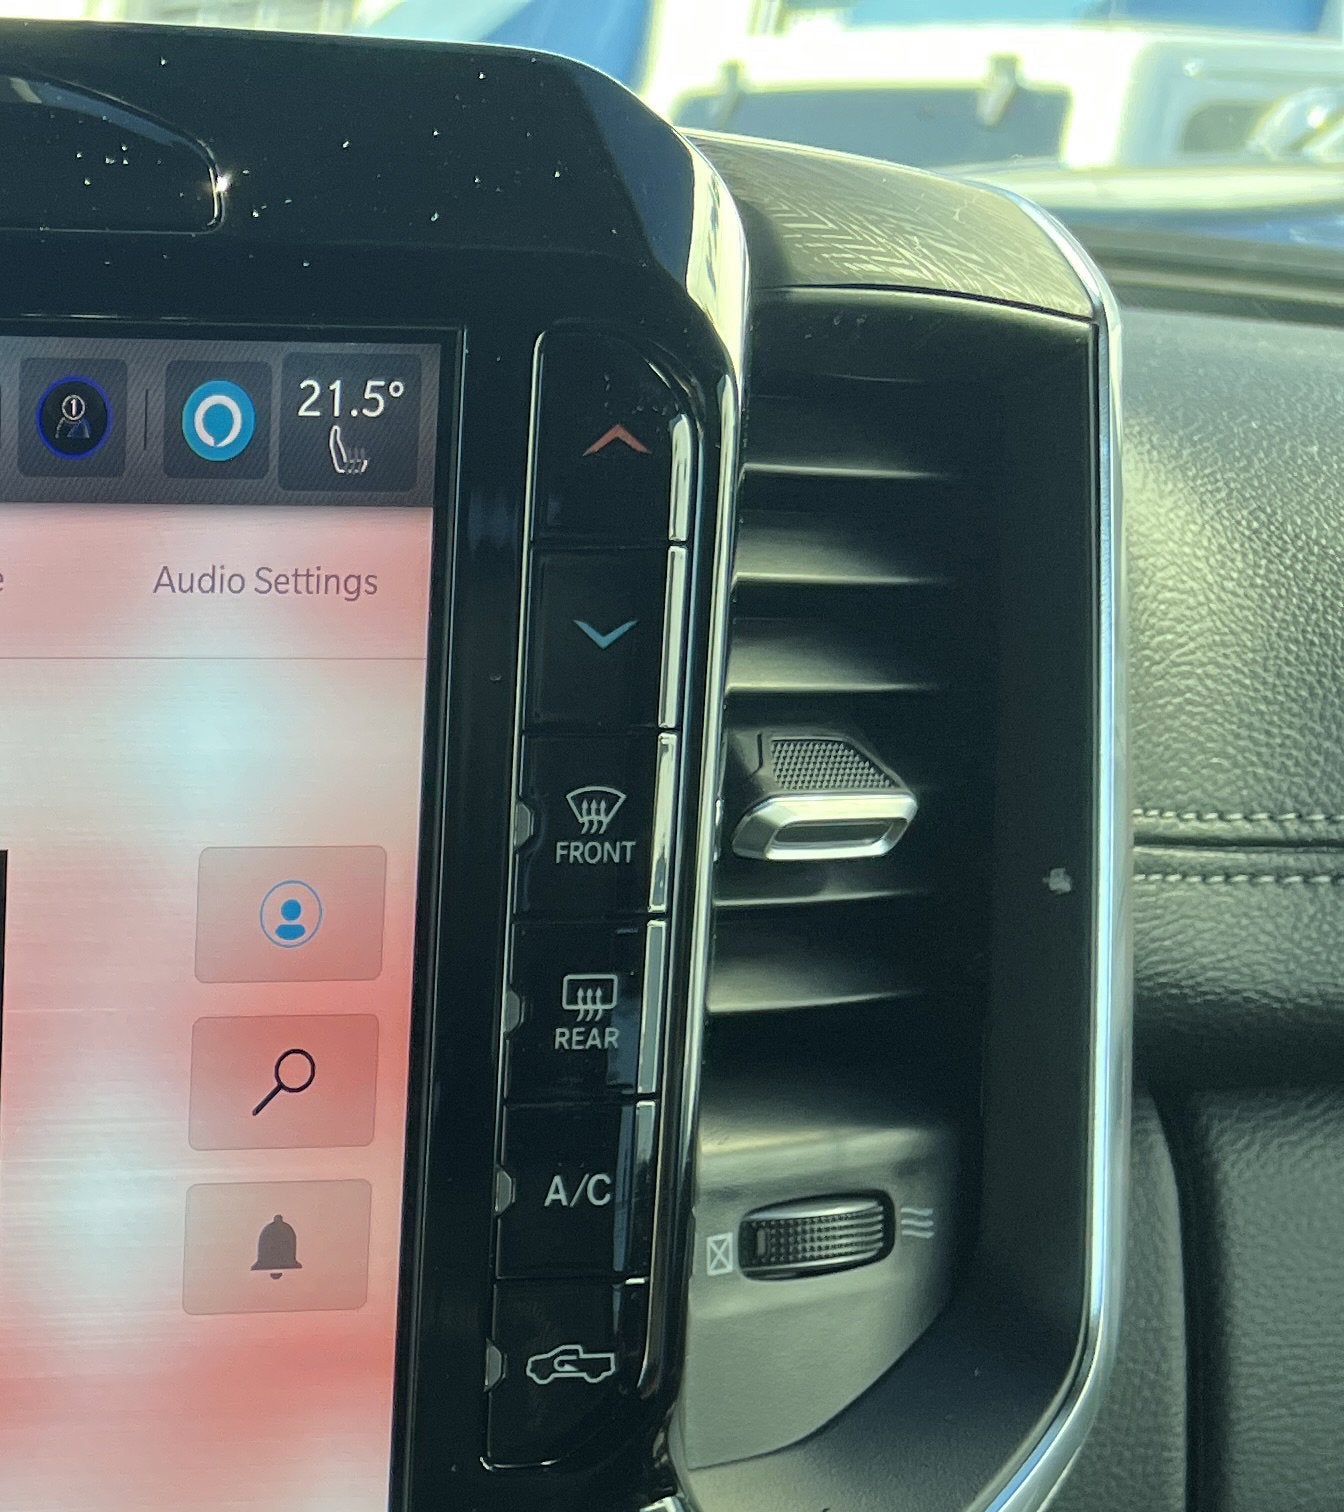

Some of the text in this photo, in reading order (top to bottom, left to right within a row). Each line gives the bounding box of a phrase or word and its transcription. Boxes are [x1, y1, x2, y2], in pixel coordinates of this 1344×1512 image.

[297, 379, 405, 418] 21.5°
[153, 565, 379, 602] Audio Settings
[555, 841, 637, 864] FRONT
[554, 1028, 620, 1051] REAR
[544, 1174, 612, 1208] A/C
